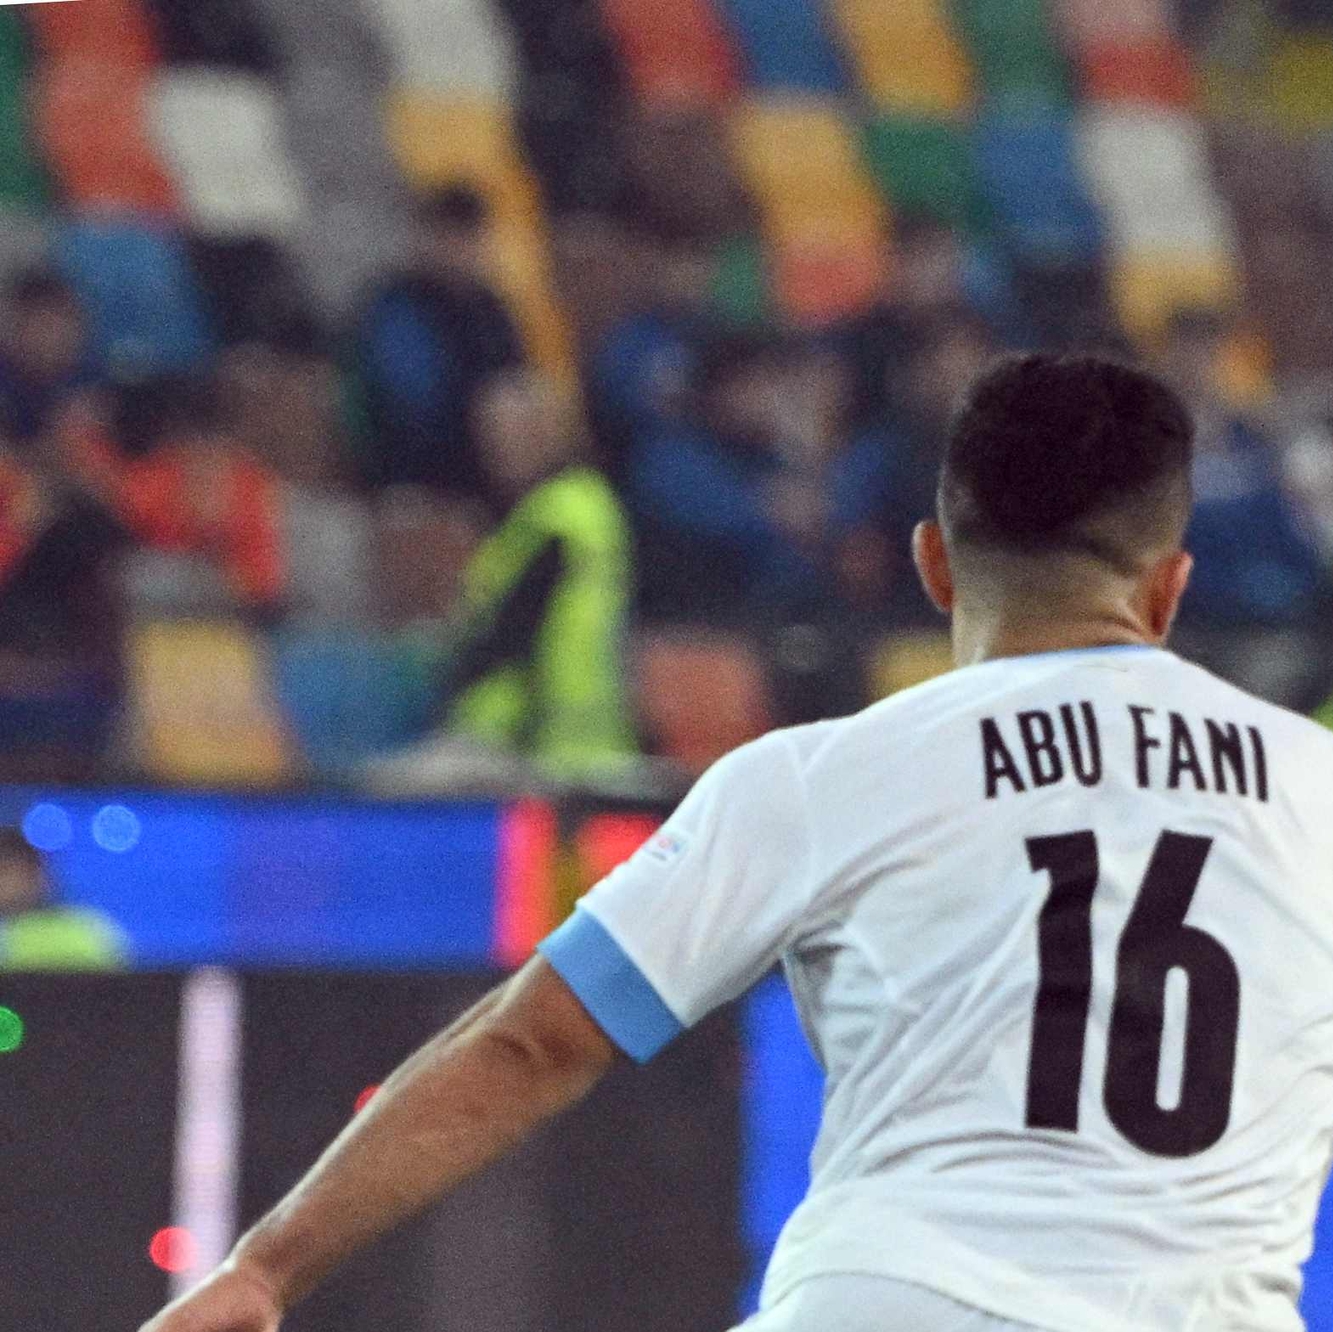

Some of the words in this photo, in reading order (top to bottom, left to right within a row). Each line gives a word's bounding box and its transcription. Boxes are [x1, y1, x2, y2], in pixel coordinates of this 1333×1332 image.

[980, 700, 1102, 799] ABU
[1127, 703, 1269, 803] FANI
[1024, 829, 1241, 1157] 16
